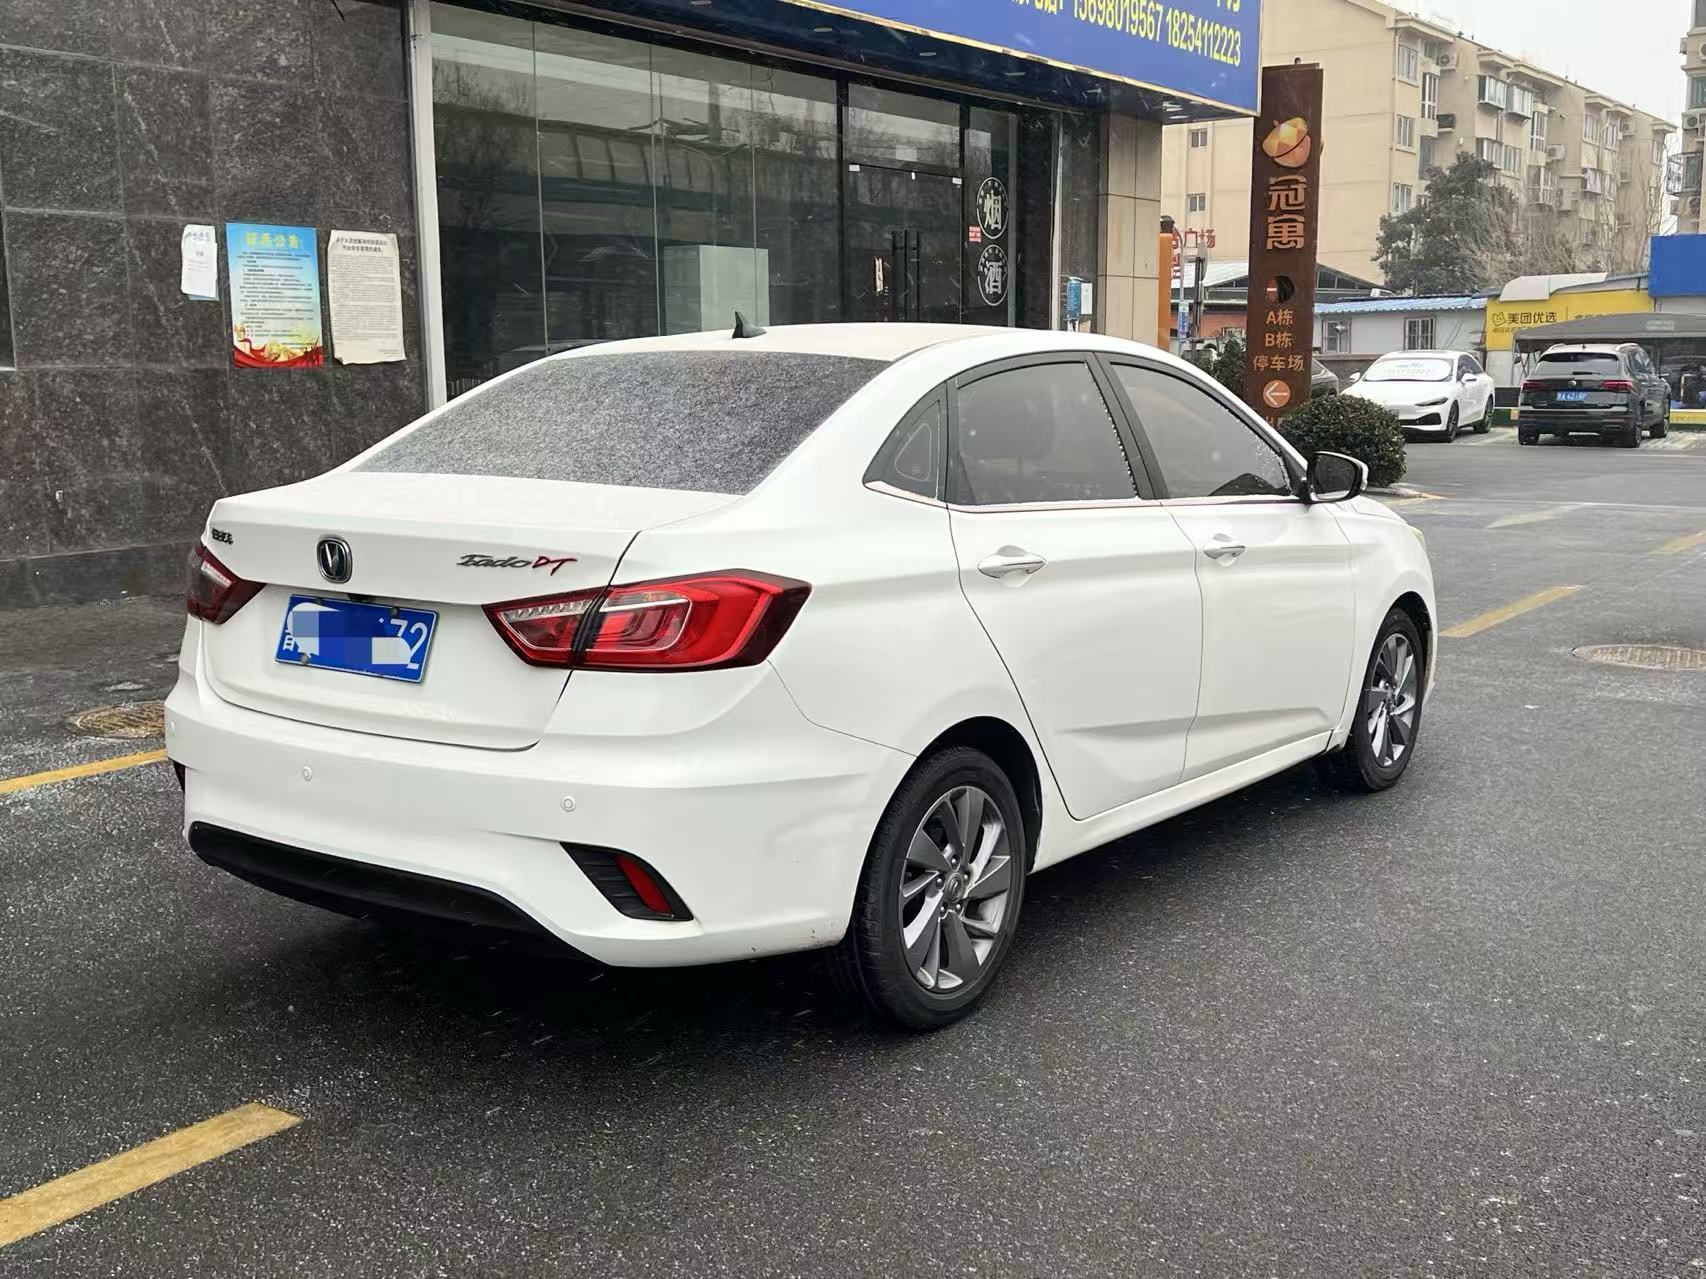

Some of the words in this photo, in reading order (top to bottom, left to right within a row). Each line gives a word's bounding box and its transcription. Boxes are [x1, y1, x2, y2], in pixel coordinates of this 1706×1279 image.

[1166, 8, 1241, 67] 18254112223
[984, 190, 1002, 229] 烟
[1266, 176, 1308, 249] 冠寓
[984, 260, 1002, 294] 酒
[1266, 309, 1294, 326] A栋
[1507, 311, 1557, 324] 美团优选
[1265, 332, 1293, 348] B栋
[1252, 355, 1305, 372] 停车场
